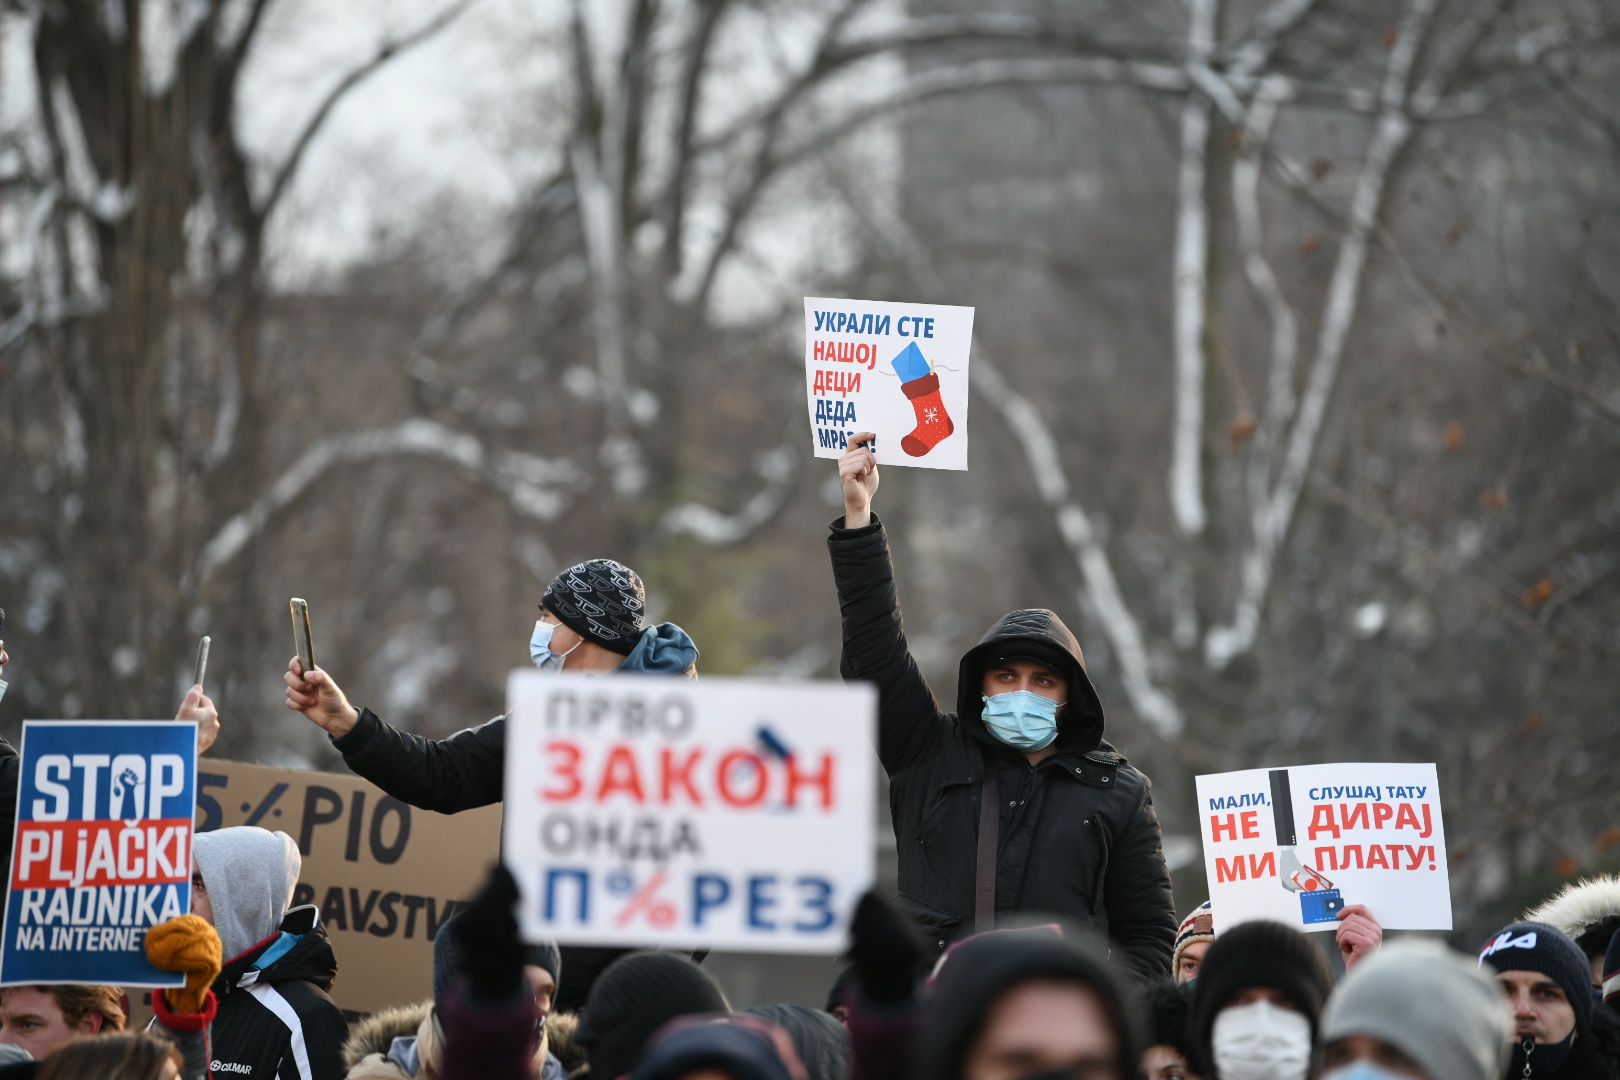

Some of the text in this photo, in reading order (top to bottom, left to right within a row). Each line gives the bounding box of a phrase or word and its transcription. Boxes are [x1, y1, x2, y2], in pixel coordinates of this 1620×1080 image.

[813, 310, 935, 339] УКРАЛИ СТЕ
[813, 340, 877, 370] НАШОЈ
[813, 370, 861, 398] ДЕЦИ
[815, 399, 857, 428] ДЕДА
[548, 690, 696, 738] ПРВО
[31, 753, 185, 823] STOP
[538, 741, 834, 811] ЗАКОН
[1209, 785, 1427, 811] МАЛИ, СЛУШАЈ ТАТУ
[299, 785, 412, 865] PIO
[540, 813, 702, 860] ОНДА
[1210, 802, 1433, 843] НЕ ДИРАЈ
[1214, 843, 1437, 884] МИ ПЛАТУ!
[18, 884, 182, 927] RADNIKA
[541, 865, 838, 933] П%РЕЗ
[15, 926, 150, 952] NA INTERNE
